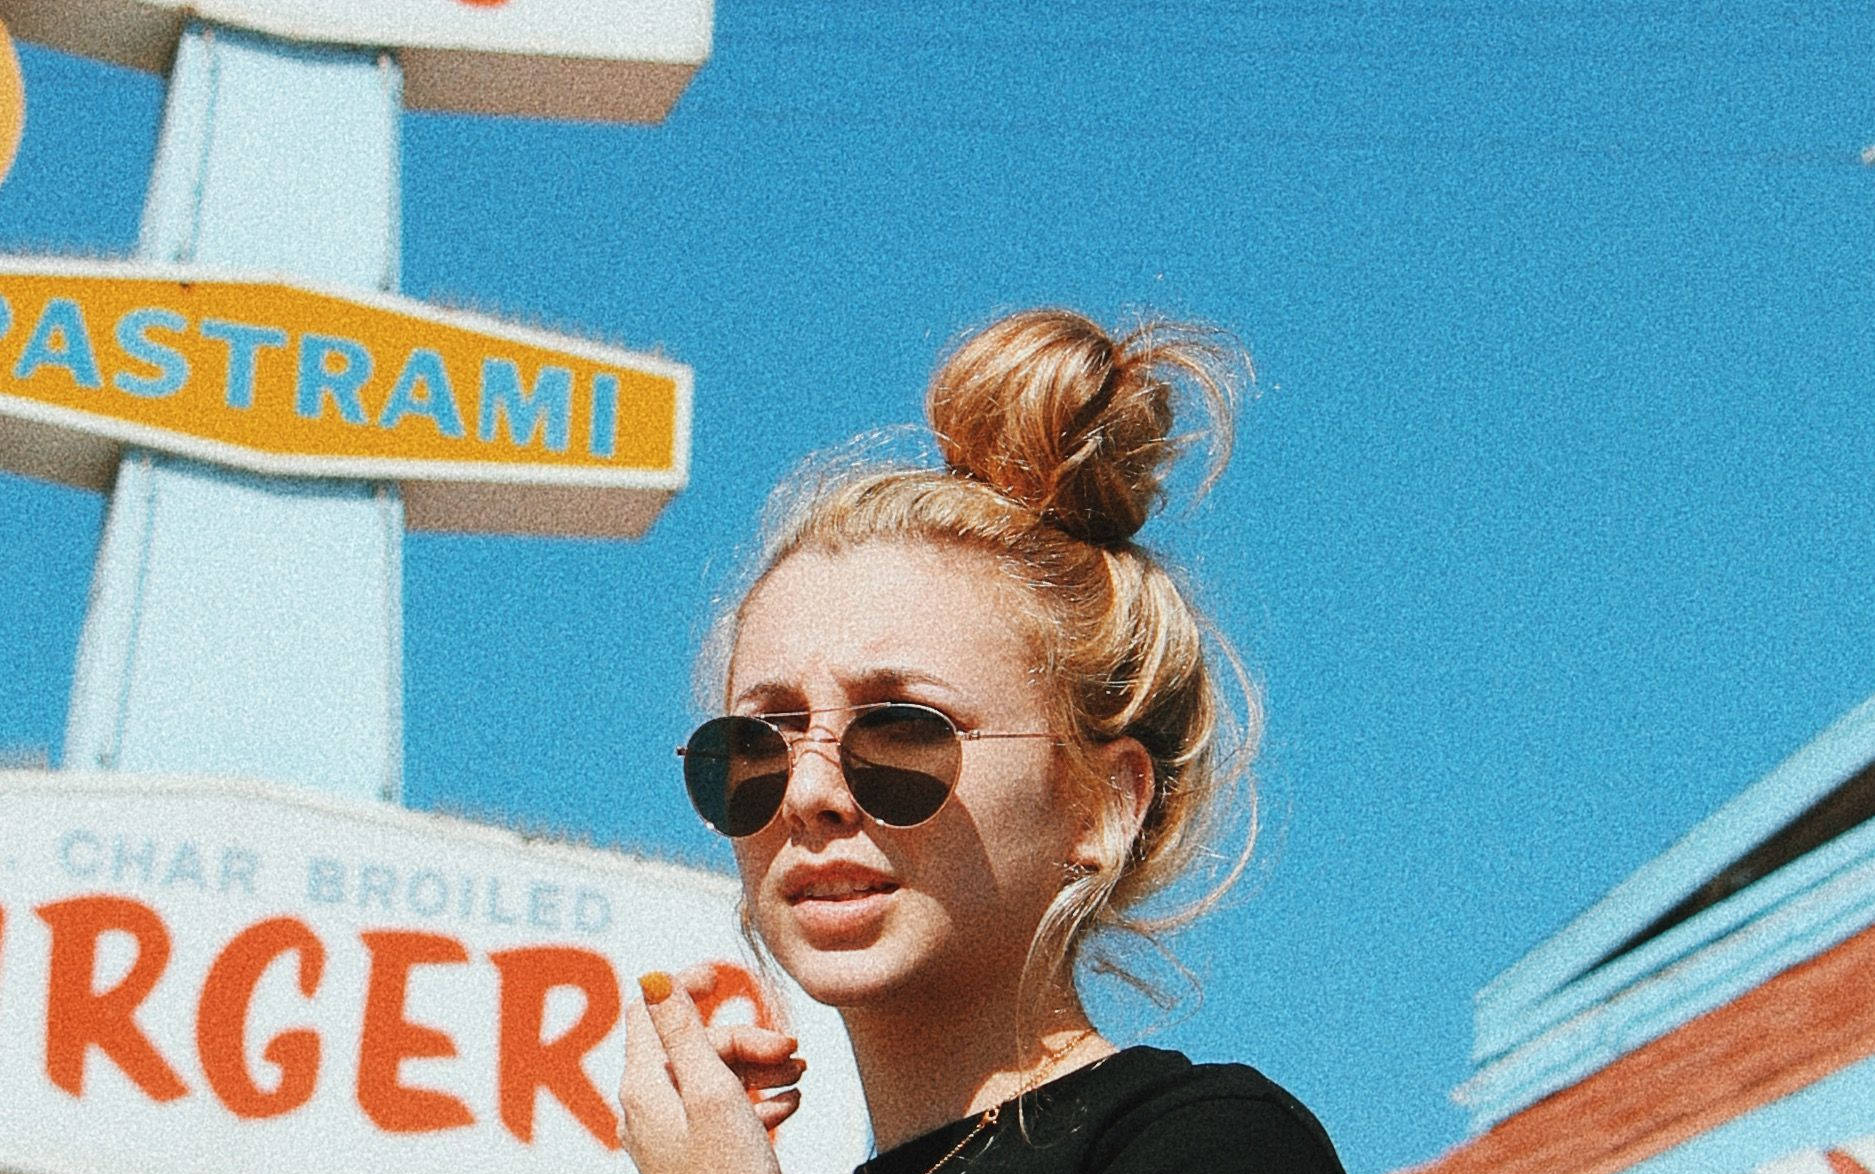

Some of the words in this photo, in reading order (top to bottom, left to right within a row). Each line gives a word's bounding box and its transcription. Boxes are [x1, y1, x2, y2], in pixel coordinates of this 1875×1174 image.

[0, 292, 620, 459] ASTRAMI
[58, 828, 263, 896] CHAR
[306, 855, 614, 936] BROILED
[0, 892, 784, 1153] RGER
